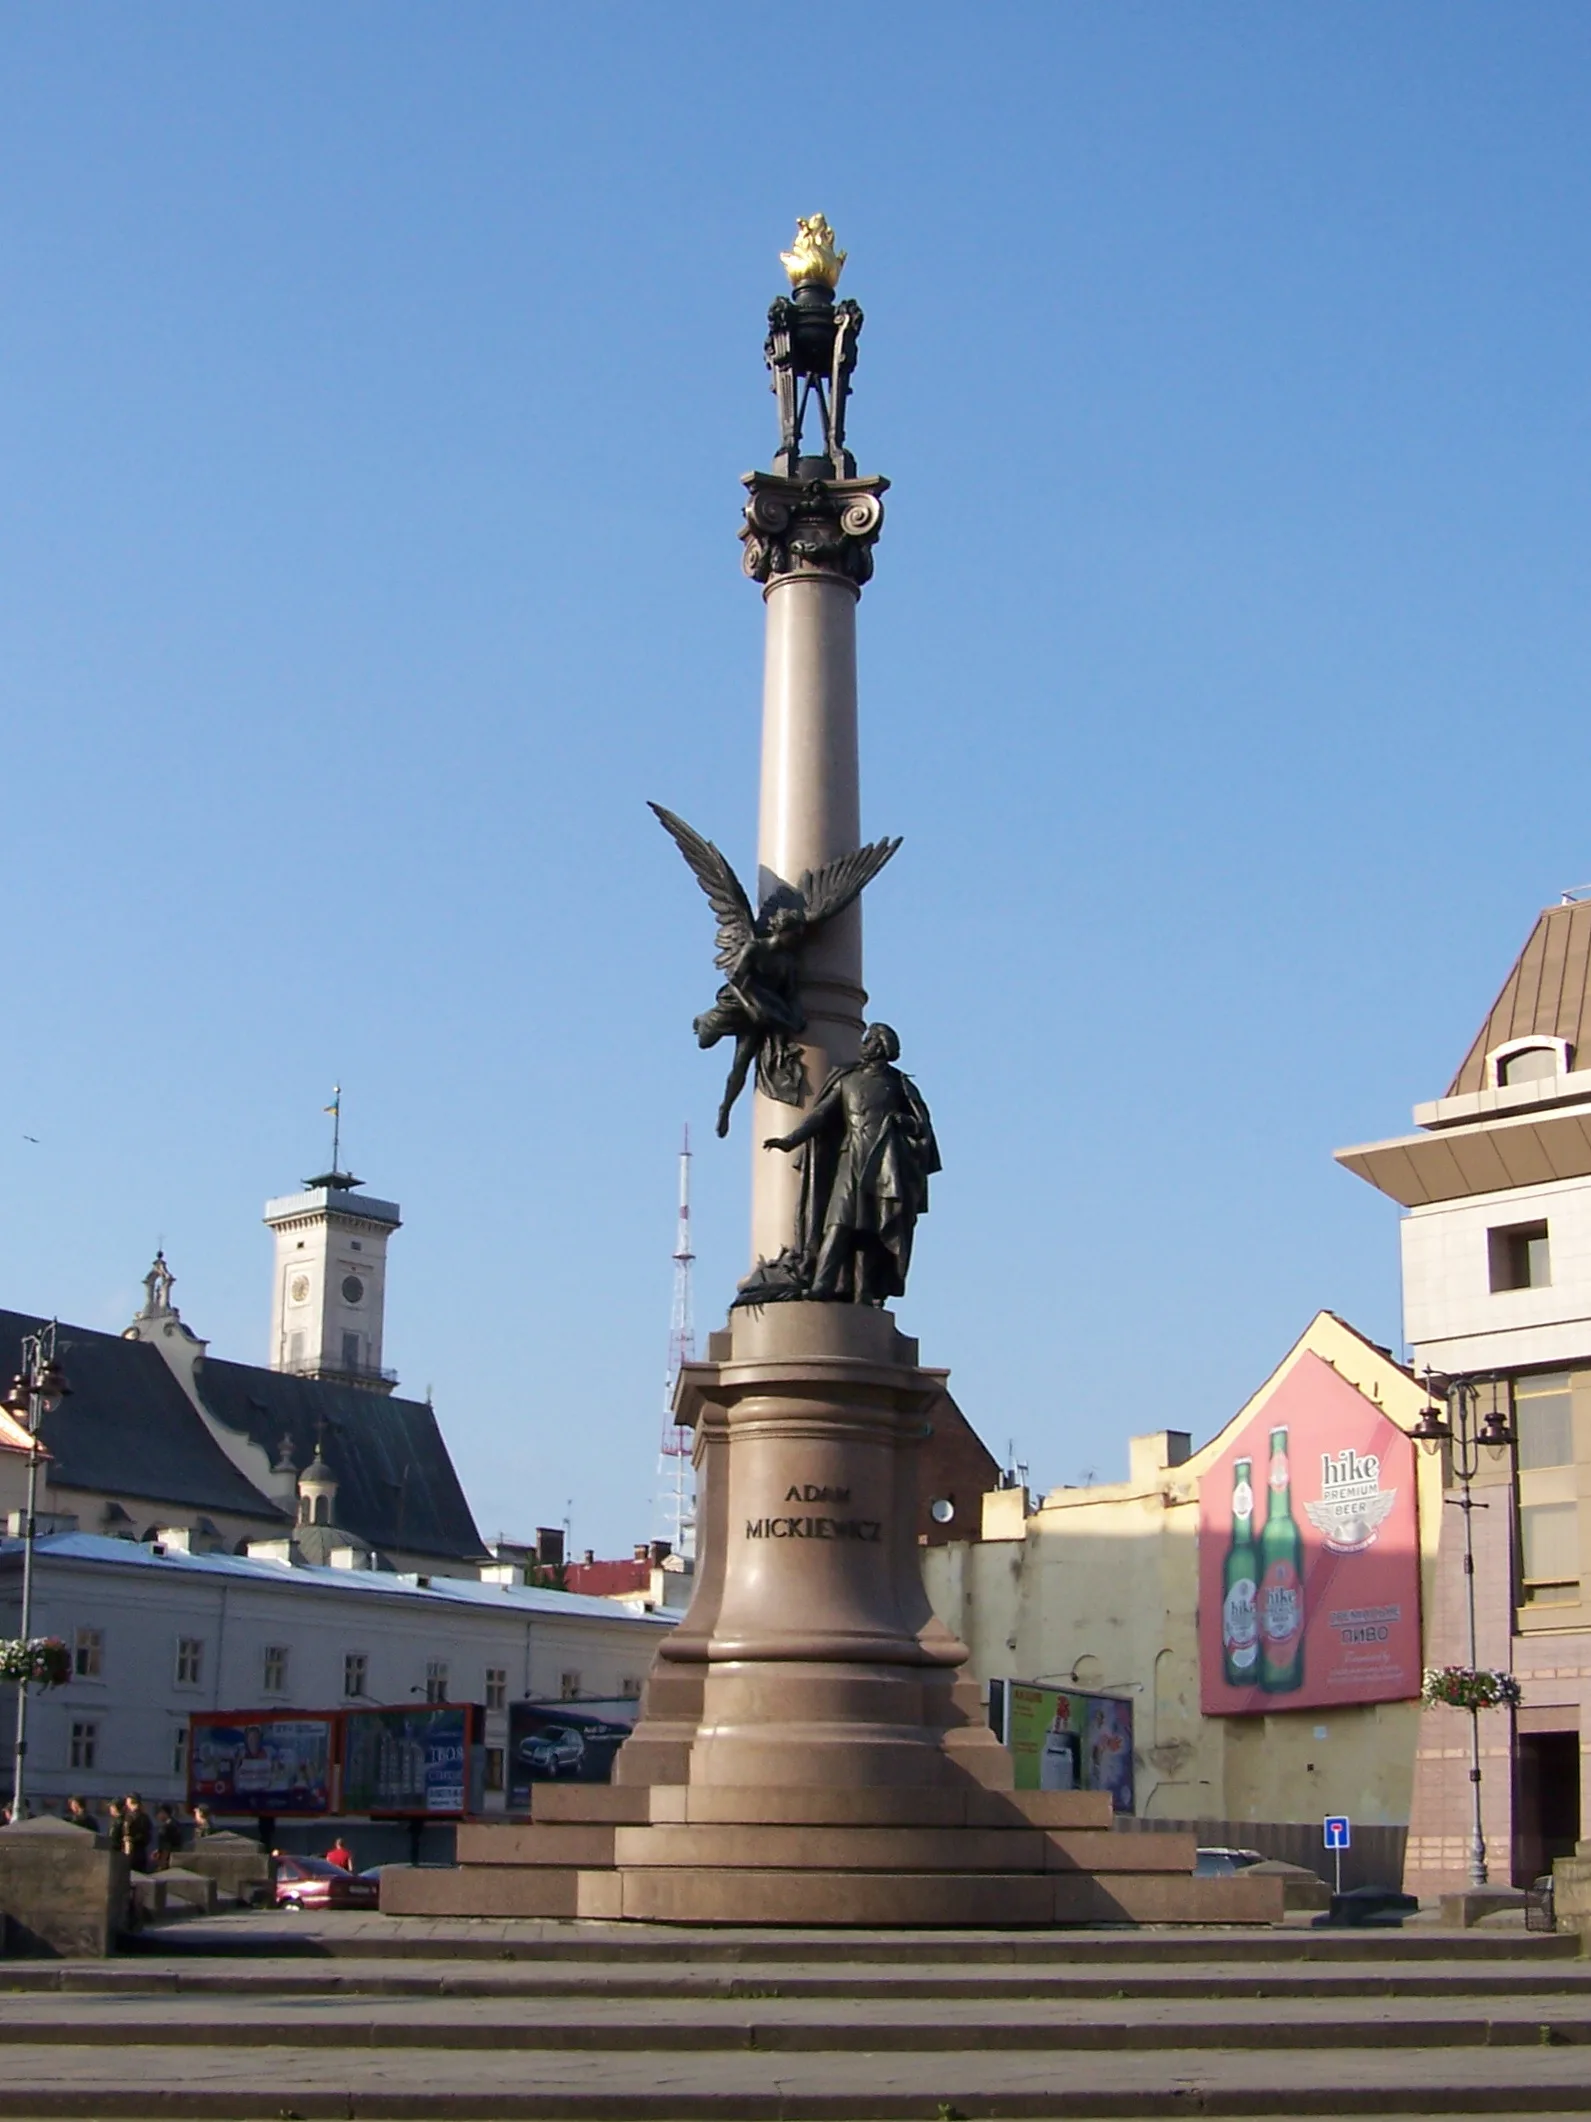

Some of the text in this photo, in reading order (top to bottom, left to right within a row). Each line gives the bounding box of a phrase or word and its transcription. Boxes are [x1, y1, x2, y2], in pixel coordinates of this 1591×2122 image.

[1322, 1450, 1378, 1484] hike
[785, 1485, 851, 1503] ADAM
[1324, 1484, 1378, 1500] PREMIUM
[1335, 1502, 1367, 1516] BEER
[746, 1517, 882, 1541] MICKIEWICZ
[1341, 1626, 1388, 1644] ПИВО
